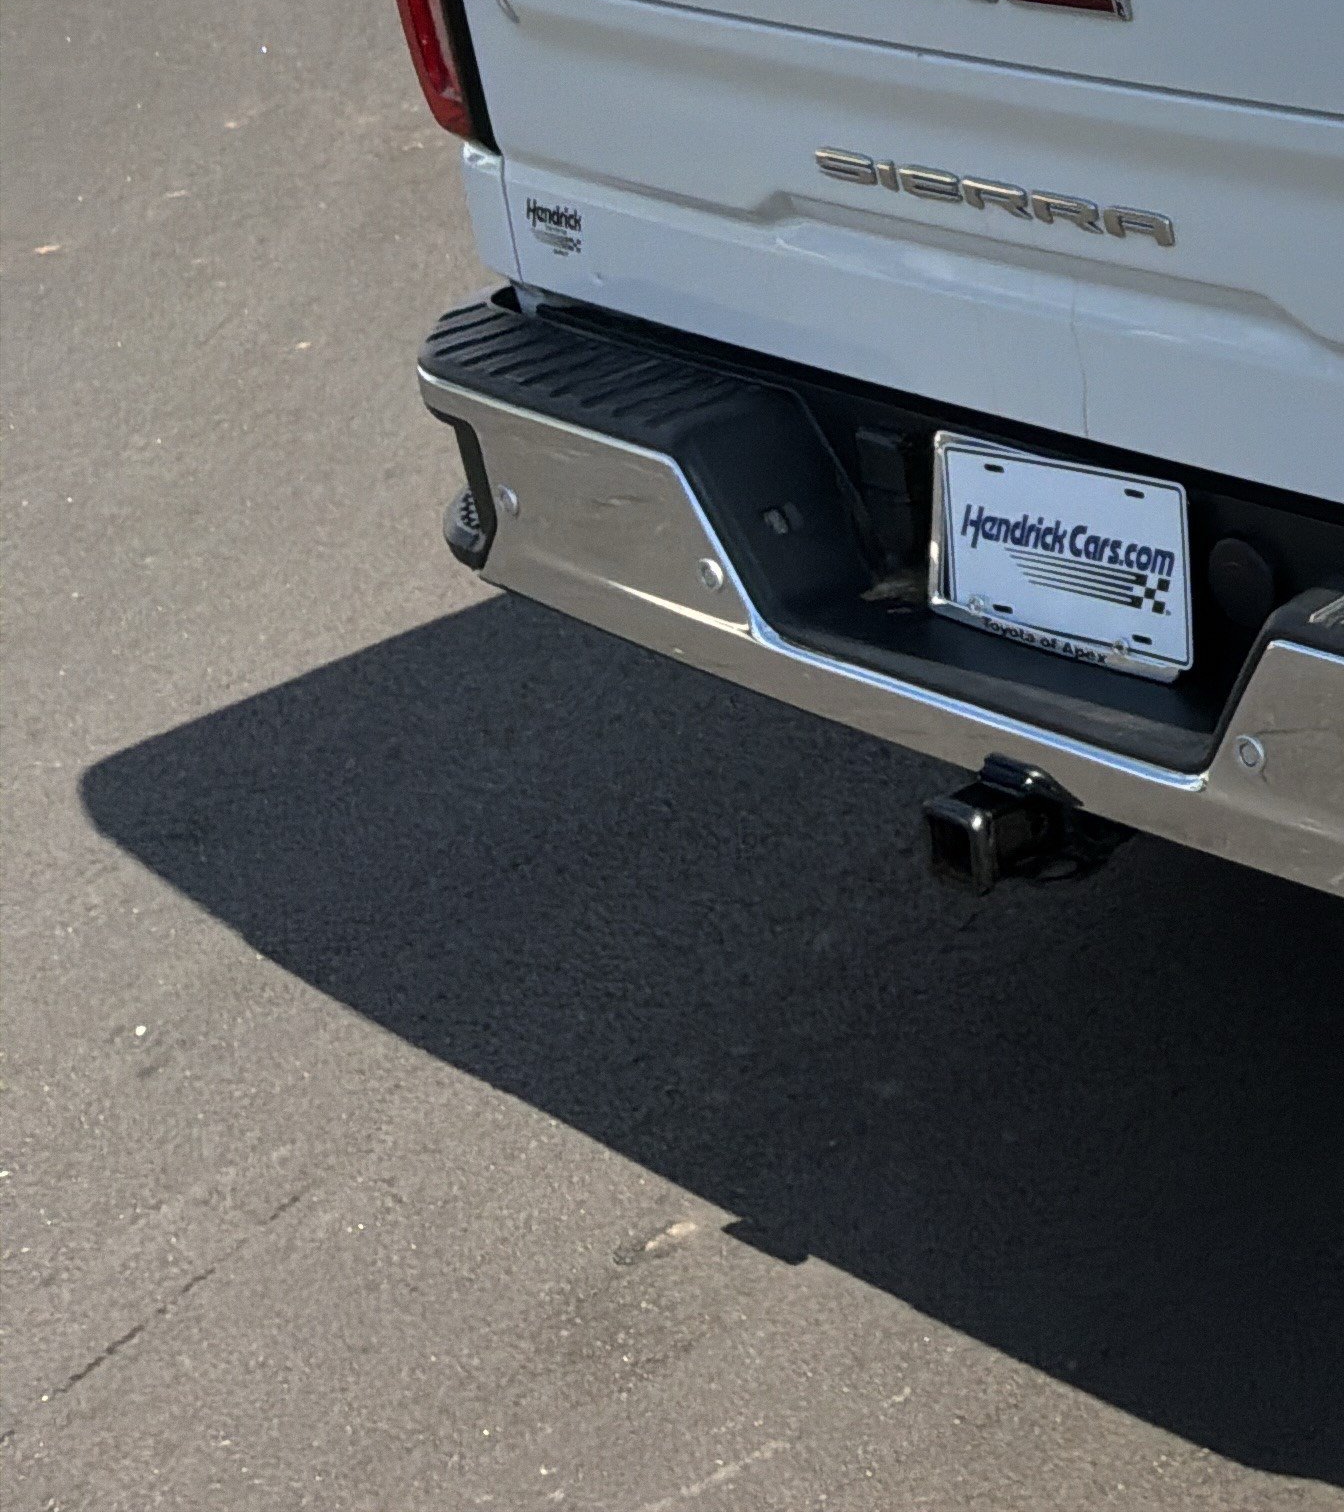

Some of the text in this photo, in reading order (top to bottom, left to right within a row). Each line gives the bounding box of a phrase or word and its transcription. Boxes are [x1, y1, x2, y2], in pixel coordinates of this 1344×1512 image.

[526, 197, 582, 232] Hendrick
[814, 146, 1176, 248] SIERRA
[981, 615, 1108, 665] Toyota of Apex
